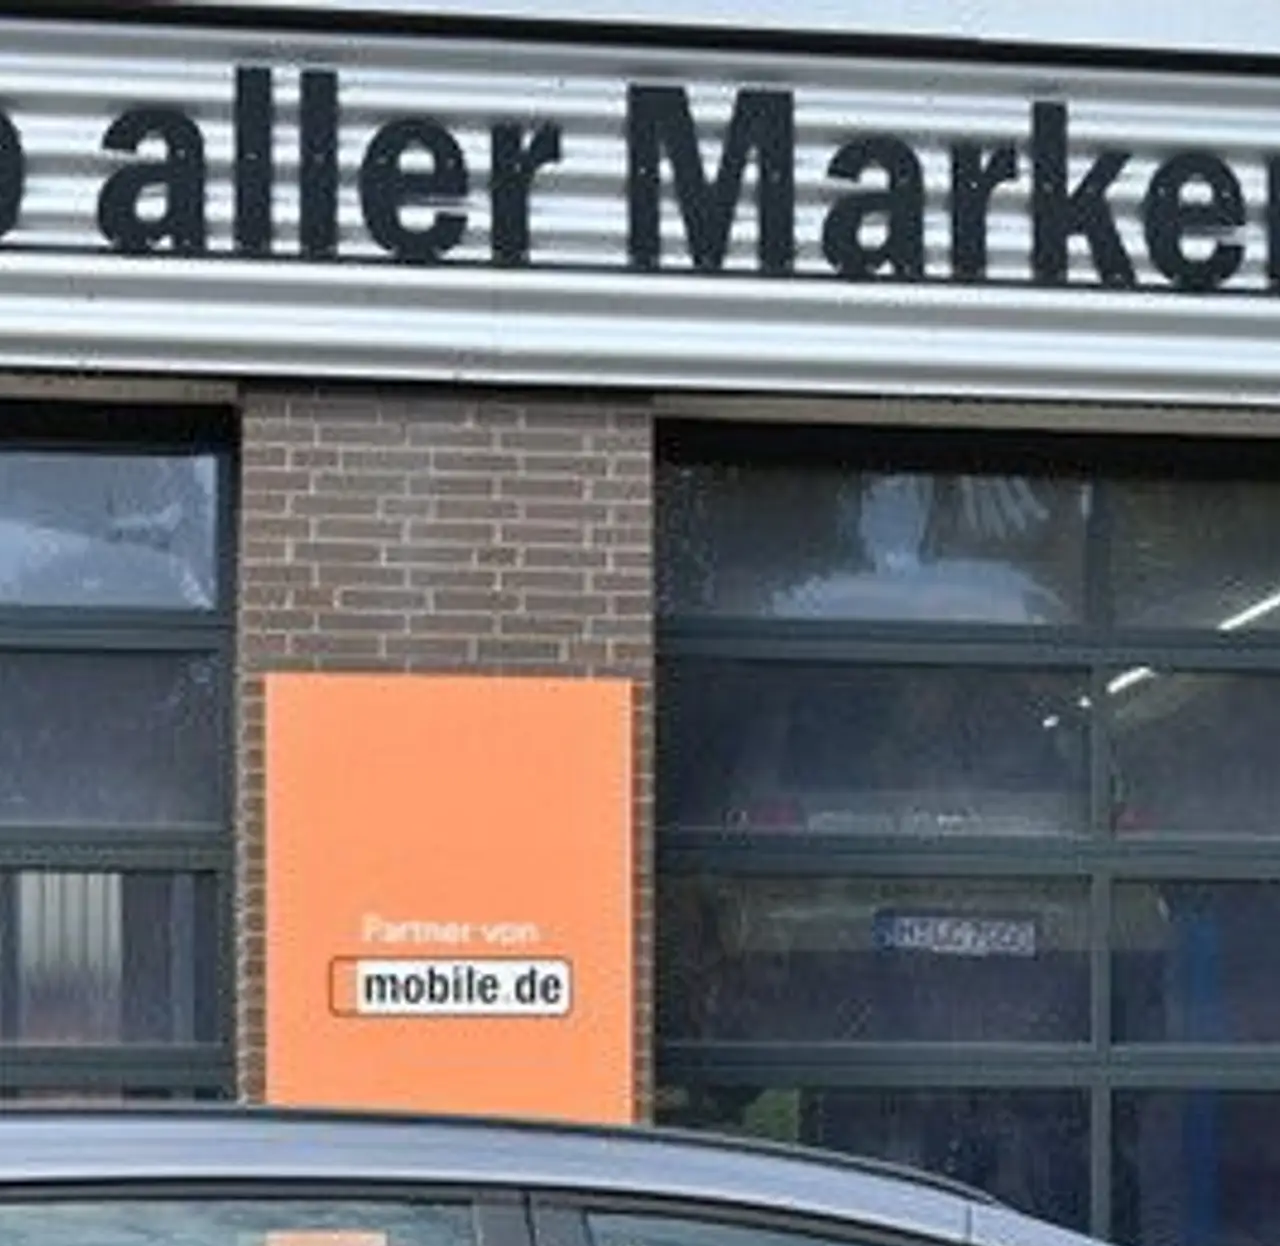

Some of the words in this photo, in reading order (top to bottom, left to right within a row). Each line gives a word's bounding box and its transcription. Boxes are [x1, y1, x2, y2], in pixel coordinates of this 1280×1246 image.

[97, 67, 562, 263] aller
[362, 913, 470, 944] Partner
[480, 921, 540, 946] von
